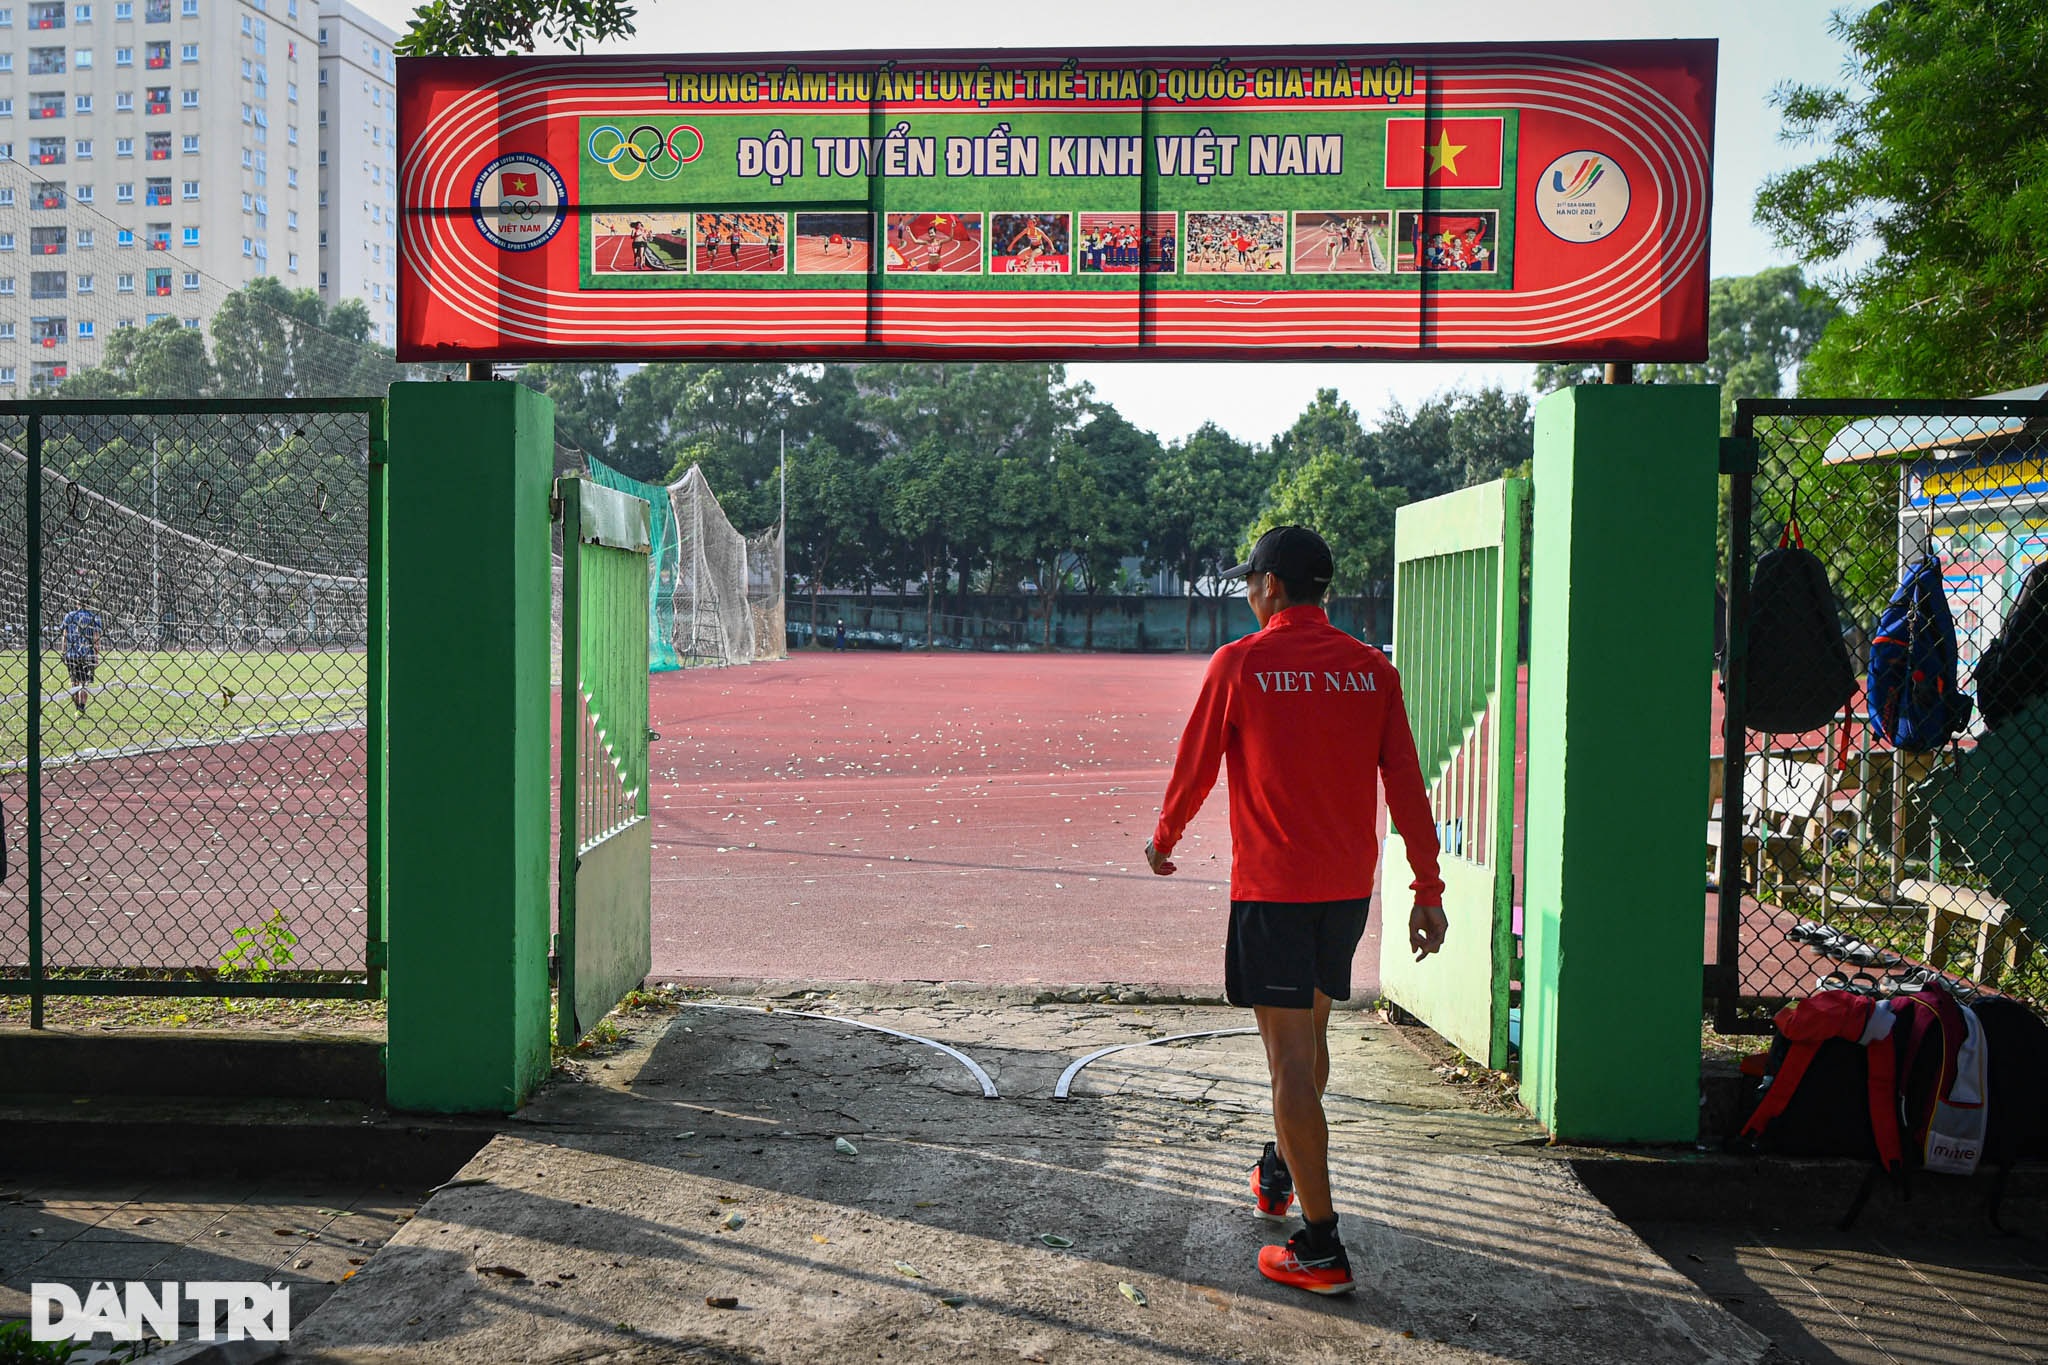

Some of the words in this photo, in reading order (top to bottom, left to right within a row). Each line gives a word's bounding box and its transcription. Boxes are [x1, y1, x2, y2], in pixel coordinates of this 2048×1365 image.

[665, 72, 759, 102] TRUNG
[767, 65, 828, 102] TÂM
[835, 60, 916, 101] HUẤN
[923, 64, 1015, 107] LUYỆN
[1023, 58, 1077, 99] THỂ
[1084, 69, 1159, 99] THAO
[1167, 58, 1247, 102] QUỐC
[1254, 67, 1304, 98] GIA
[1313, 60, 1352, 98] HÀ
[1362, 59, 1415, 104] NỘI
[738, 130, 803, 184] ĐỘI
[813, 122, 935, 177] TUYỂN
[945, 123, 1038, 177] ĐIỀN
[1049, 136, 1144, 176] KINH
[1154, 128, 1239, 184] VIỆT
[1249, 135, 1343, 175] NAM
[498, 223, 517, 235] VIỆT
[1254, 671, 1315, 693] VIET
[1324, 671, 1377, 692] NAM
